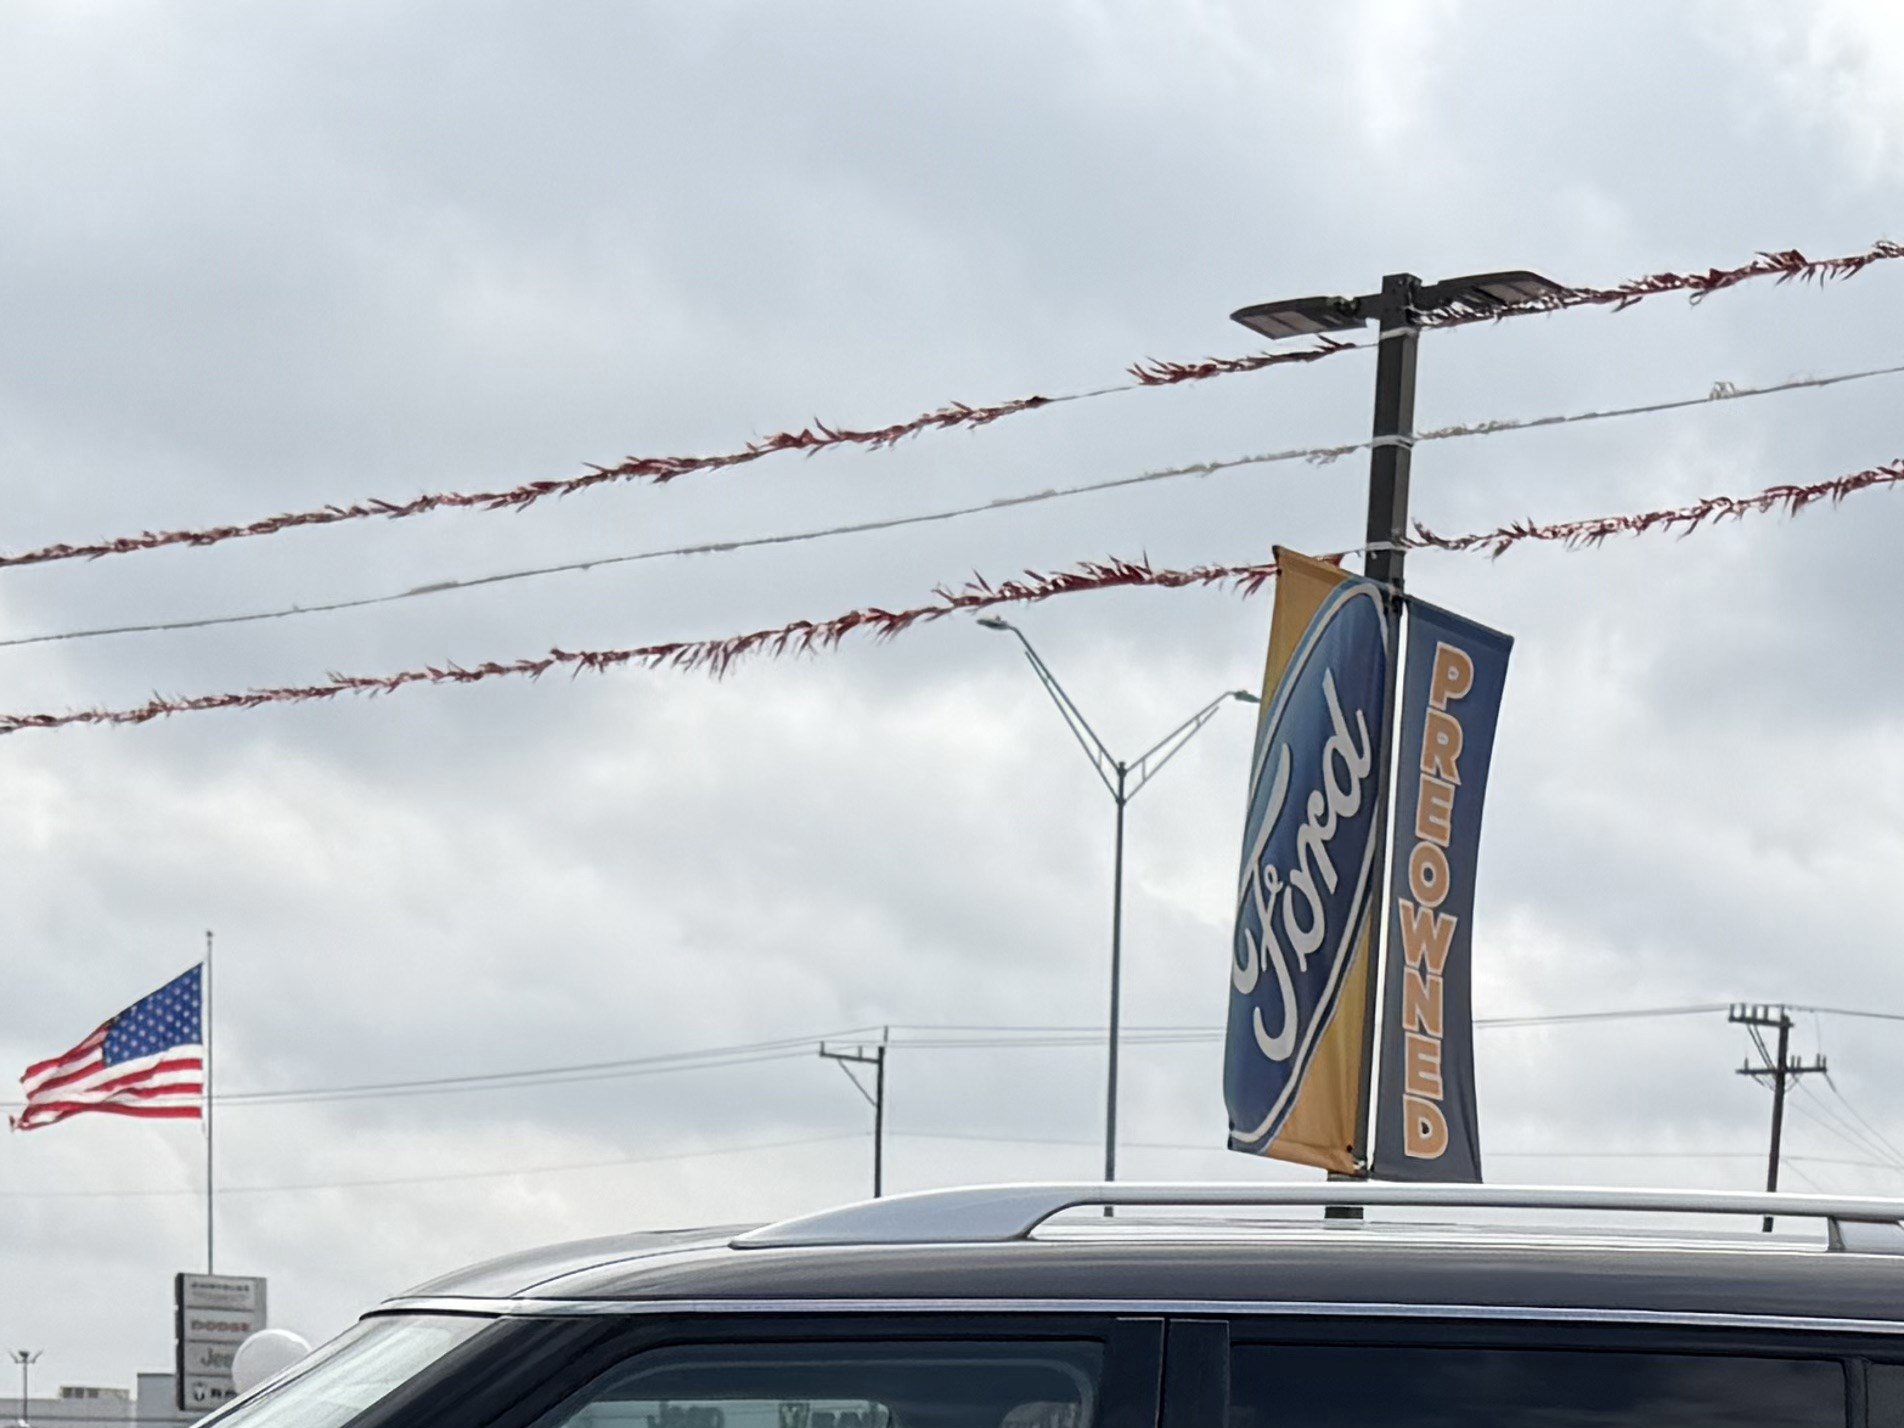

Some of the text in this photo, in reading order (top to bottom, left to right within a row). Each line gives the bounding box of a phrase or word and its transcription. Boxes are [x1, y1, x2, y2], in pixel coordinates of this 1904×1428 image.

[1231, 667, 1373, 1062] Ford
[1398, 641, 1475, 1160] PREOWNED
[200, 1347, 235, 1369] Jee
